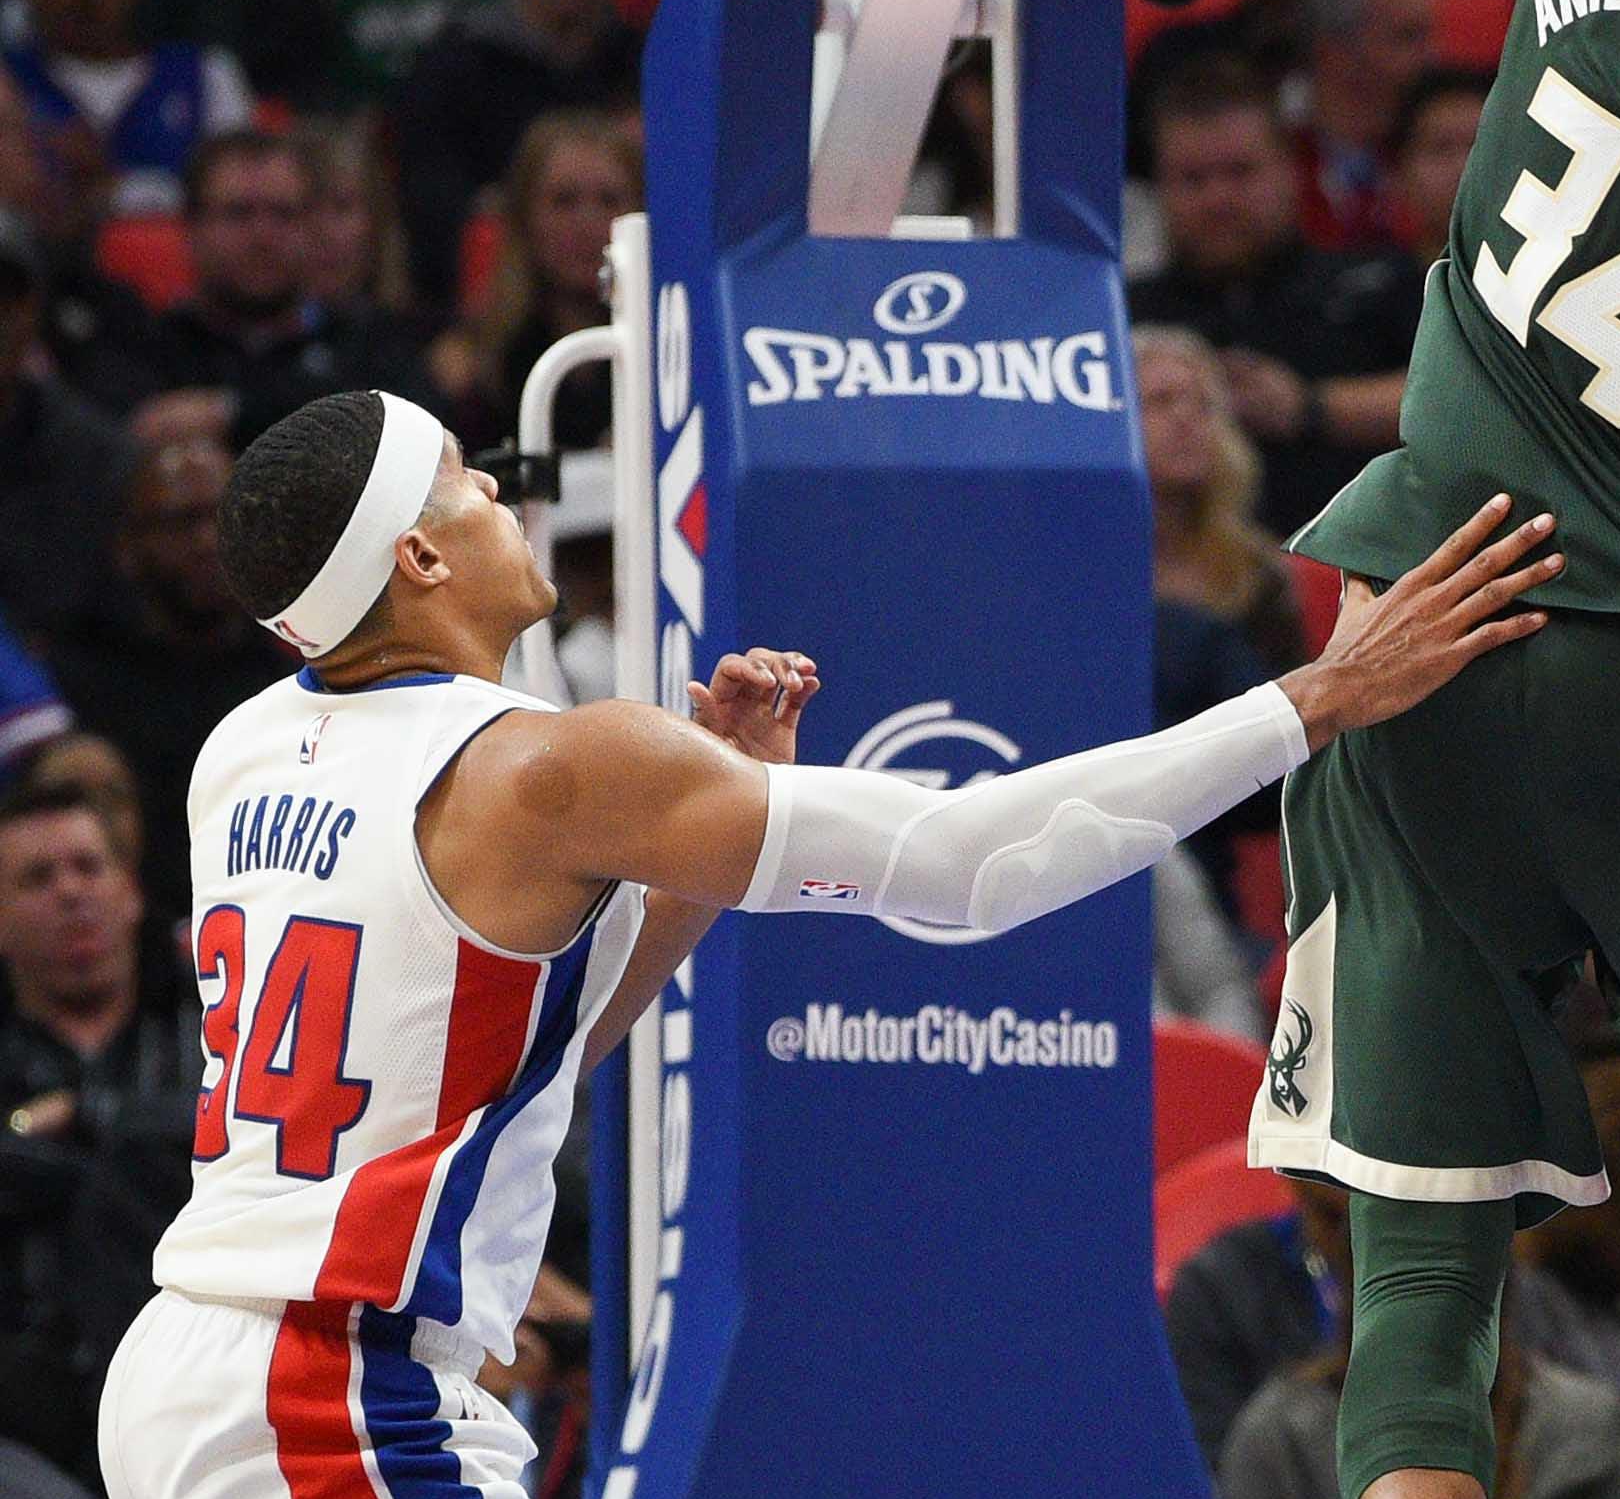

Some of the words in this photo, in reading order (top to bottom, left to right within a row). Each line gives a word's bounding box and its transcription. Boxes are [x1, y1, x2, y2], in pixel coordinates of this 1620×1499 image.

[744, 326, 1114, 411] SPALDING
[227, 793, 356, 881] HARRIS
[193, 903, 372, 1182] 34
[766, 1003, 1118, 1075] @MotorCityCasino
